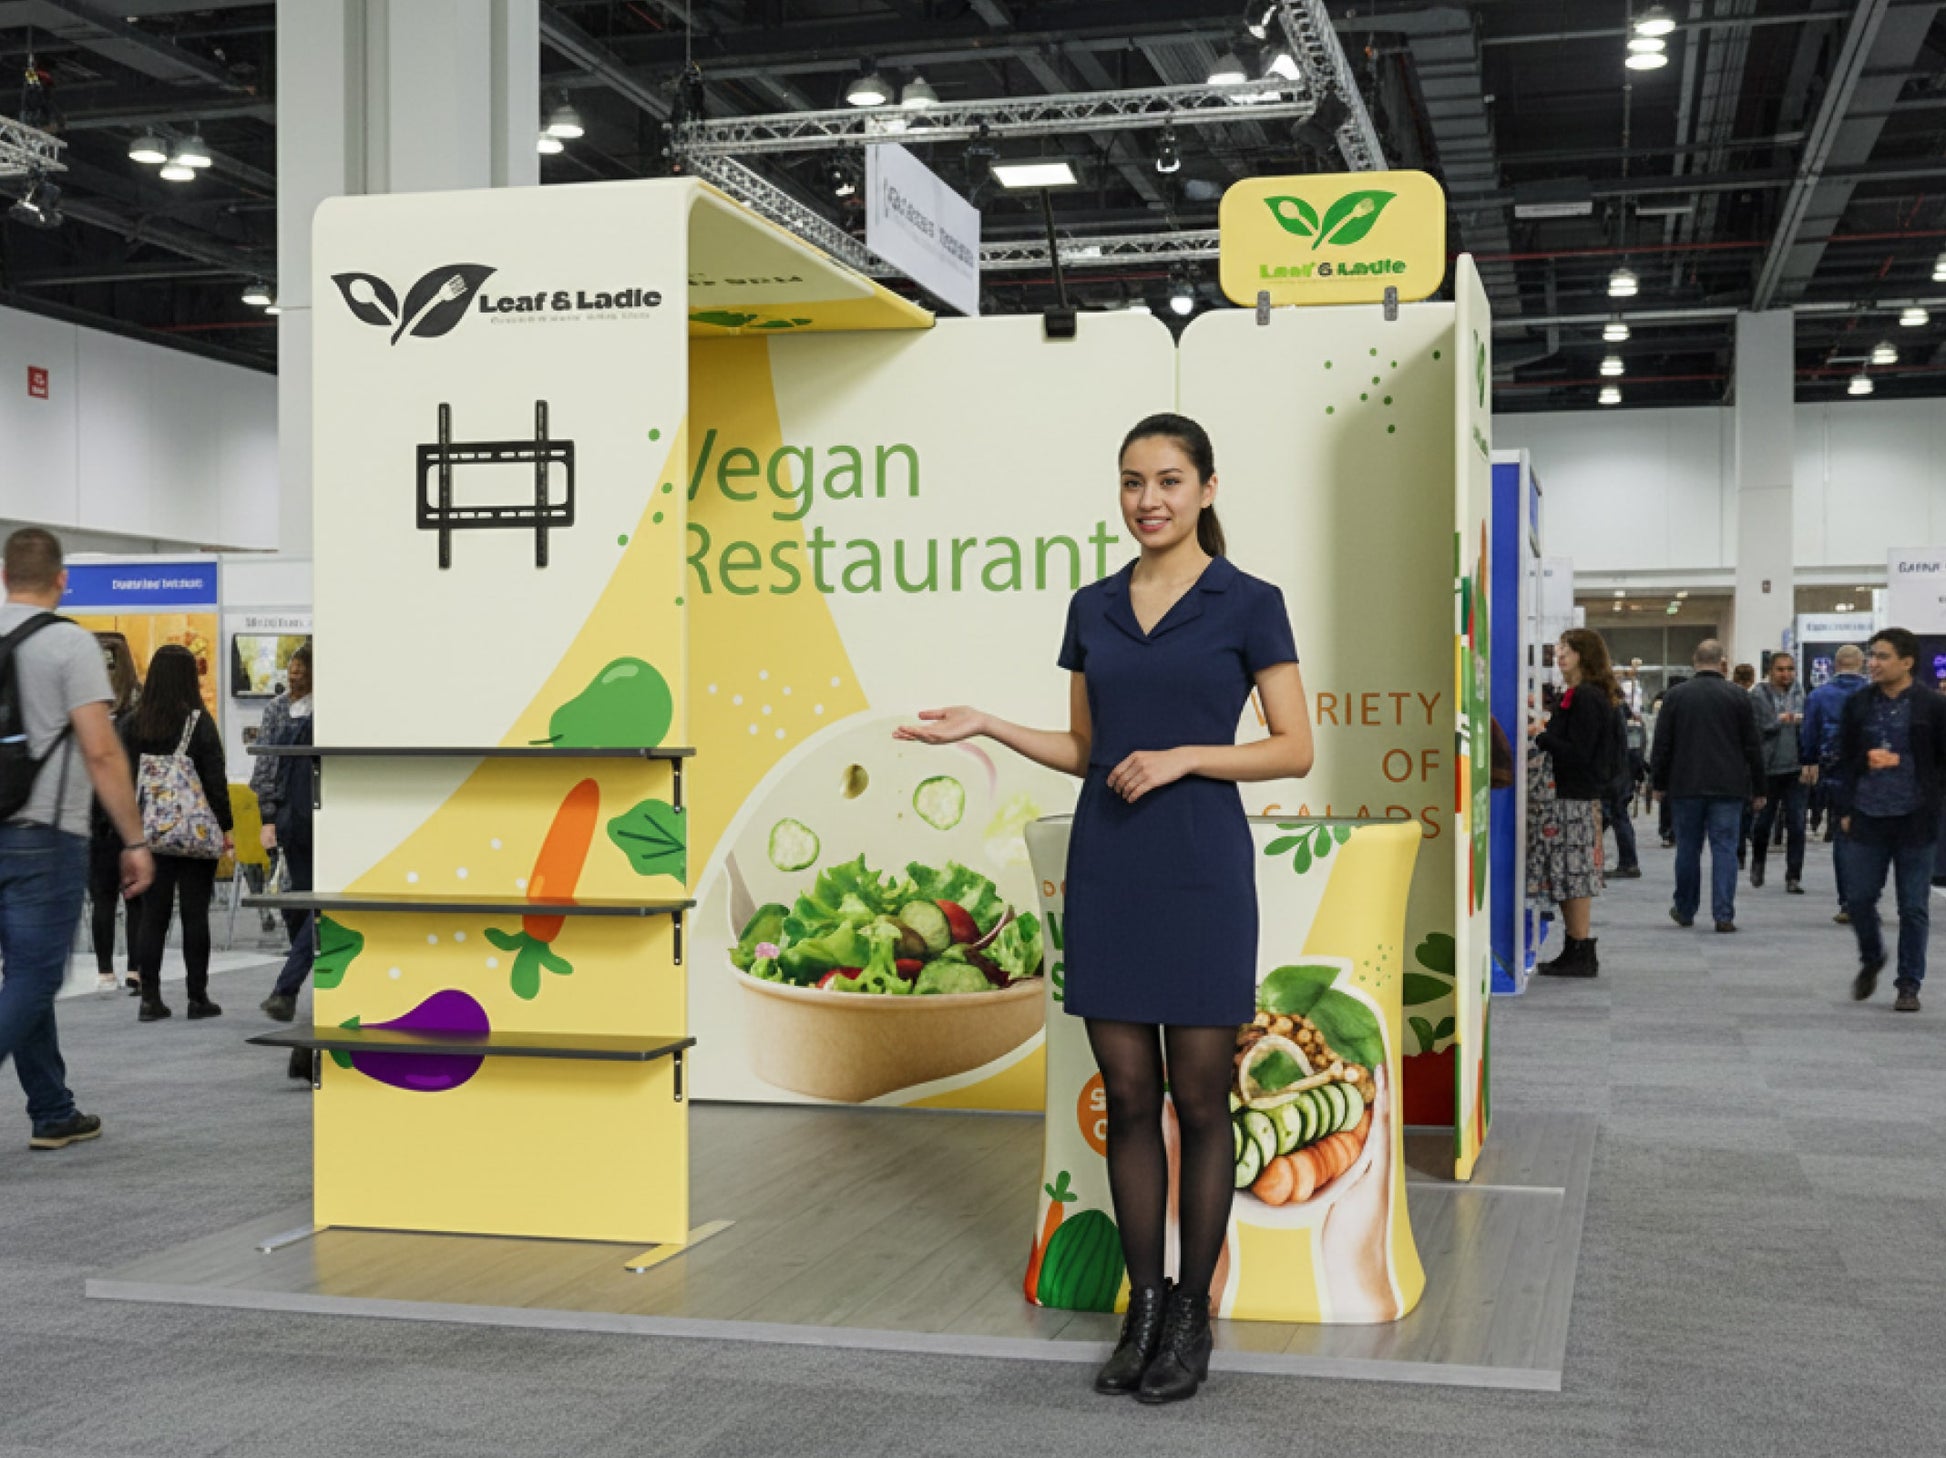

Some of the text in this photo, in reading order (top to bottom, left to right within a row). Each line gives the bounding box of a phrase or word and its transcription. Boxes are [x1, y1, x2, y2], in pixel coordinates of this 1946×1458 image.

[479, 291, 547, 313] Leaf
[551, 290, 572, 311] &
[686, 520, 1120, 596] Restaurant
[1251, 691, 1441, 727] RIETY
[1382, 748, 1440, 783] OF
